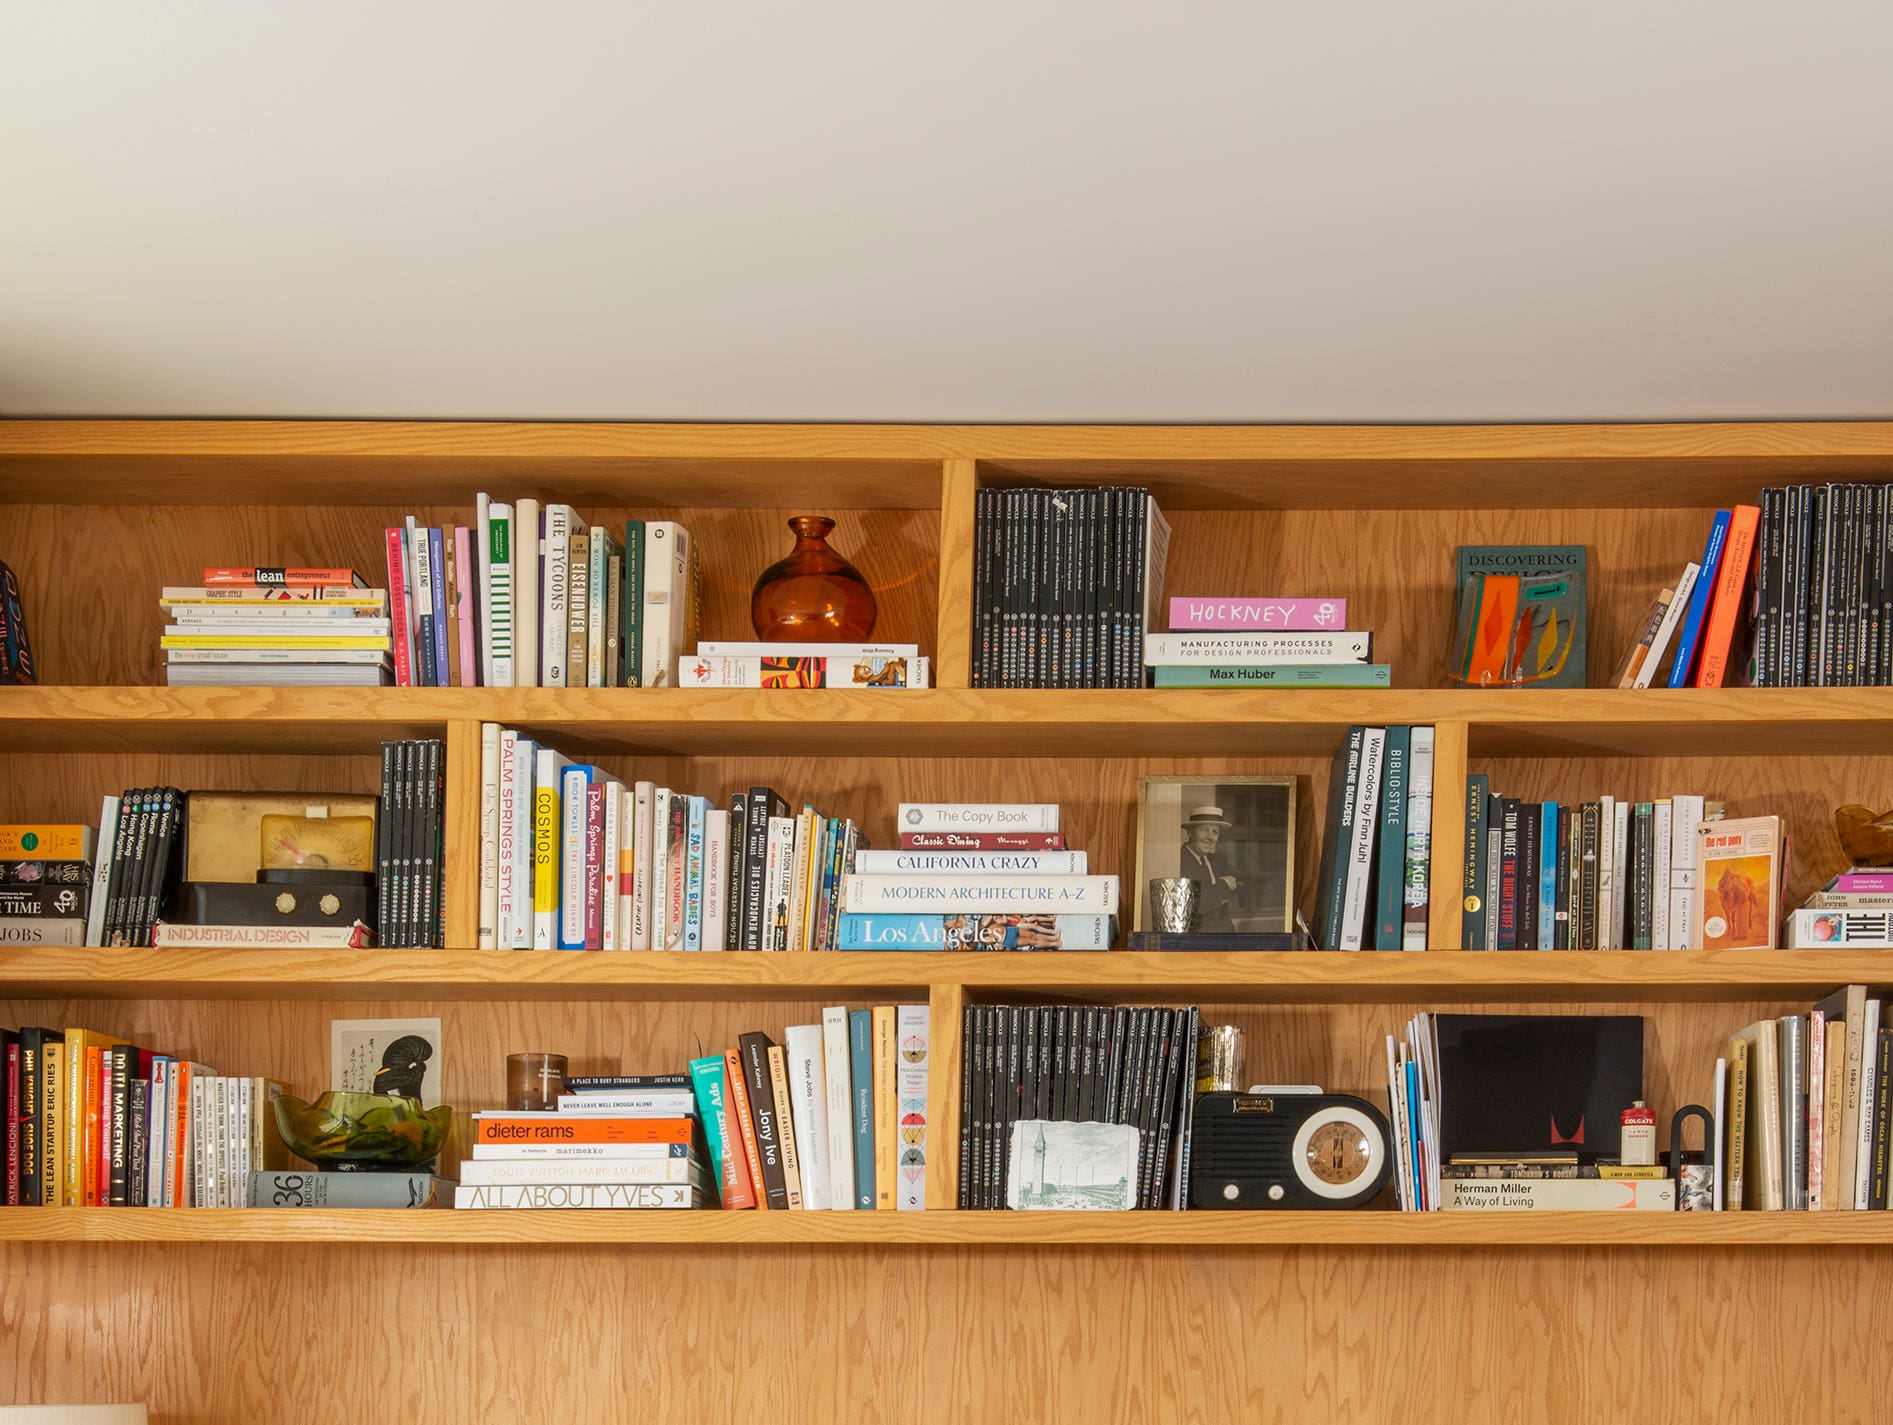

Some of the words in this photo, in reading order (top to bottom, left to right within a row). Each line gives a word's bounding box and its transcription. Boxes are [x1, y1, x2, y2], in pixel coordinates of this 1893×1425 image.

[391, 543, 402, 574] BEHIND
[417, 539, 427, 554] TRUE
[418, 556, 428, 587] PORTLAND
[1469, 555, 1577, 566] DISCOVERING
[256, 569, 285, 582] lean
[551, 546, 566, 611] TYCOONS
[206, 590, 226, 598] GRAPHIC
[227, 590, 242, 598] STYLE
[394, 576, 402, 608] CLOSED
[571, 563, 586, 633] EISENHOWER
[396, 610, 404, 638] DOORS
[1188, 603, 1296, 626] HOCKNEY
[1247, 648, 1332, 656] PROFESSIONALS
[1210, 669, 1236, 679] Max
[1238, 669, 1276, 679] Huber
[1351, 732, 1360, 749] THE
[503, 738, 513, 783] PALM
[1347, 750, 1358, 783] AIRLINE
[1365, 737, 1381, 801] Watercolors
[588, 789, 601, 823] Palm
[1342, 785, 1354, 827] BUILDERS
[1415, 775, 1427, 817] INSIDE
[120, 815, 128, 829] Los
[936, 810, 959, 822] The
[962, 810, 994, 824] Copy
[997, 810, 1029, 822] Book
[1361, 803, 1374, 816] by
[1505, 812, 1517, 830] TOM
[128, 814, 138, 835] Hong
[148, 812, 158, 835] Rome
[159, 812, 170, 838] Venice
[501, 788, 513, 860] SPRINGS
[537, 793, 551, 865] COSMOS
[1360, 818, 1371, 840] Finn
[116, 830, 126, 861] Angeles
[125, 836, 134, 856] Kong
[136, 813, 149, 860] Copenhagen
[587, 825, 600, 861] Springs
[691, 833, 701, 853] SAD
[912, 835, 944, 846] Classic
[946, 835, 982, 849] Dining
[1413, 820, 1427, 860] NORTH
[1504, 831, 1516, 856] WOLFE
[732, 851, 740, 876] THINGS
[782, 843, 791, 871] PLATOON
[897, 856, 986, 869] CALIFORNIA
[991, 856, 1041, 869] CRAZY
[1357, 842, 1369, 864] Juhl
[690, 855, 700, 890] ANIMAL
[752, 865, 760, 878] DIE
[1504, 860, 1515, 876] THE
[500, 865, 512, 913] STYLE
[587, 864, 600, 905] Paradise
[673, 867, 682, 923] HANDBOOK
[782, 873, 790, 897] LEADER
[882, 887, 946, 899] MODERN
[950, 887, 1054, 900] ARCHITECTURE
[1411, 865, 1425, 909] KOREA
[1503, 878, 1515, 902] RIGHT
[5, 902, 42, 914] TIME
[688, 893, 698, 925] BABIES
[748, 880, 761, 931] DEMOCRACIES
[1501, 904, 1514, 929] STUFF
[167, 928, 252, 943] INDUSTRIAL
[253, 928, 311, 943] DESIGN
[729, 916, 737, 943] DESIGN
[864, 920, 907, 943] Los
[910, 920, 1003, 947] Angeles
[1094, 917, 1102, 945] TASCHEN
[1846, 913, 1886, 942] THE
[748, 933, 757, 950] HOW
[23, 1049, 34, 1072] PHIL
[113, 1053, 126, 1069] DO
[751, 1044, 761, 1068] Leander
[772, 1052, 782, 1082] WRIGHT
[47, 1063, 55, 1085] RIES
[88, 1056, 98, 1107] Contagious
[113, 1072, 126, 1088] IT!
[754, 1067, 763, 1089] Kahney
[804, 1059, 812, 1079] Steve
[23, 1075, 34, 1114] KNIGHT
[47, 1087, 55, 1111] ERIC
[103, 1076, 112, 1120] Managing
[709, 1082, 722, 1107] Ads
[860, 1088, 868, 1118] Resident
[23, 1123, 33, 1152] SHOE
[47, 1113, 55, 1155] STARTUP
[113, 1093, 124, 1168] MARKETING
[486, 1124, 531, 1139] dieter
[534, 1126, 574, 1139] rams
[759, 1109, 774, 1142] Jony
[781, 1116, 791, 1141] EASIER
[860, 1119, 868, 1134] Dog
[8, 1122, 17, 1167] LENCIONI
[103, 1122, 111, 1160] Yourself
[556, 1147, 603, 1155] marimekko
[716, 1109, 738, 1185] Mid-Century
[23, 1153, 33, 1176] DOG
[765, 1144, 777, 1165] Ive
[785, 1143, 794, 1170] LIVING
[46, 1158, 55, 1182] LEAN
[492, 1168, 525, 1177] LOUIS
[528, 1168, 576, 1177] VUITTON
[578, 1168, 609, 1176] MARC
[613, 1167, 652, 1176] JACOBS
[8, 1169, 17, 1206] PATRICK
[46, 1185, 55, 1204] THE
[273, 1174, 305, 1207] 36
[304, 1174, 314, 1207] HOURS
[470, 1186, 511, 1208] ALL
[517, 1186, 601, 1208] ABOUT
[606, 1185, 664, 1207] YVES
[1454, 1184, 1498, 1194] Herman
[1500, 1183, 1532, 1194] Miller
[1454, 1197, 1463, 1206] A
[1463, 1196, 1487, 1208] Way
[1489, 1196, 1501, 1206] of
[1502, 1196, 1534, 1208] Living
